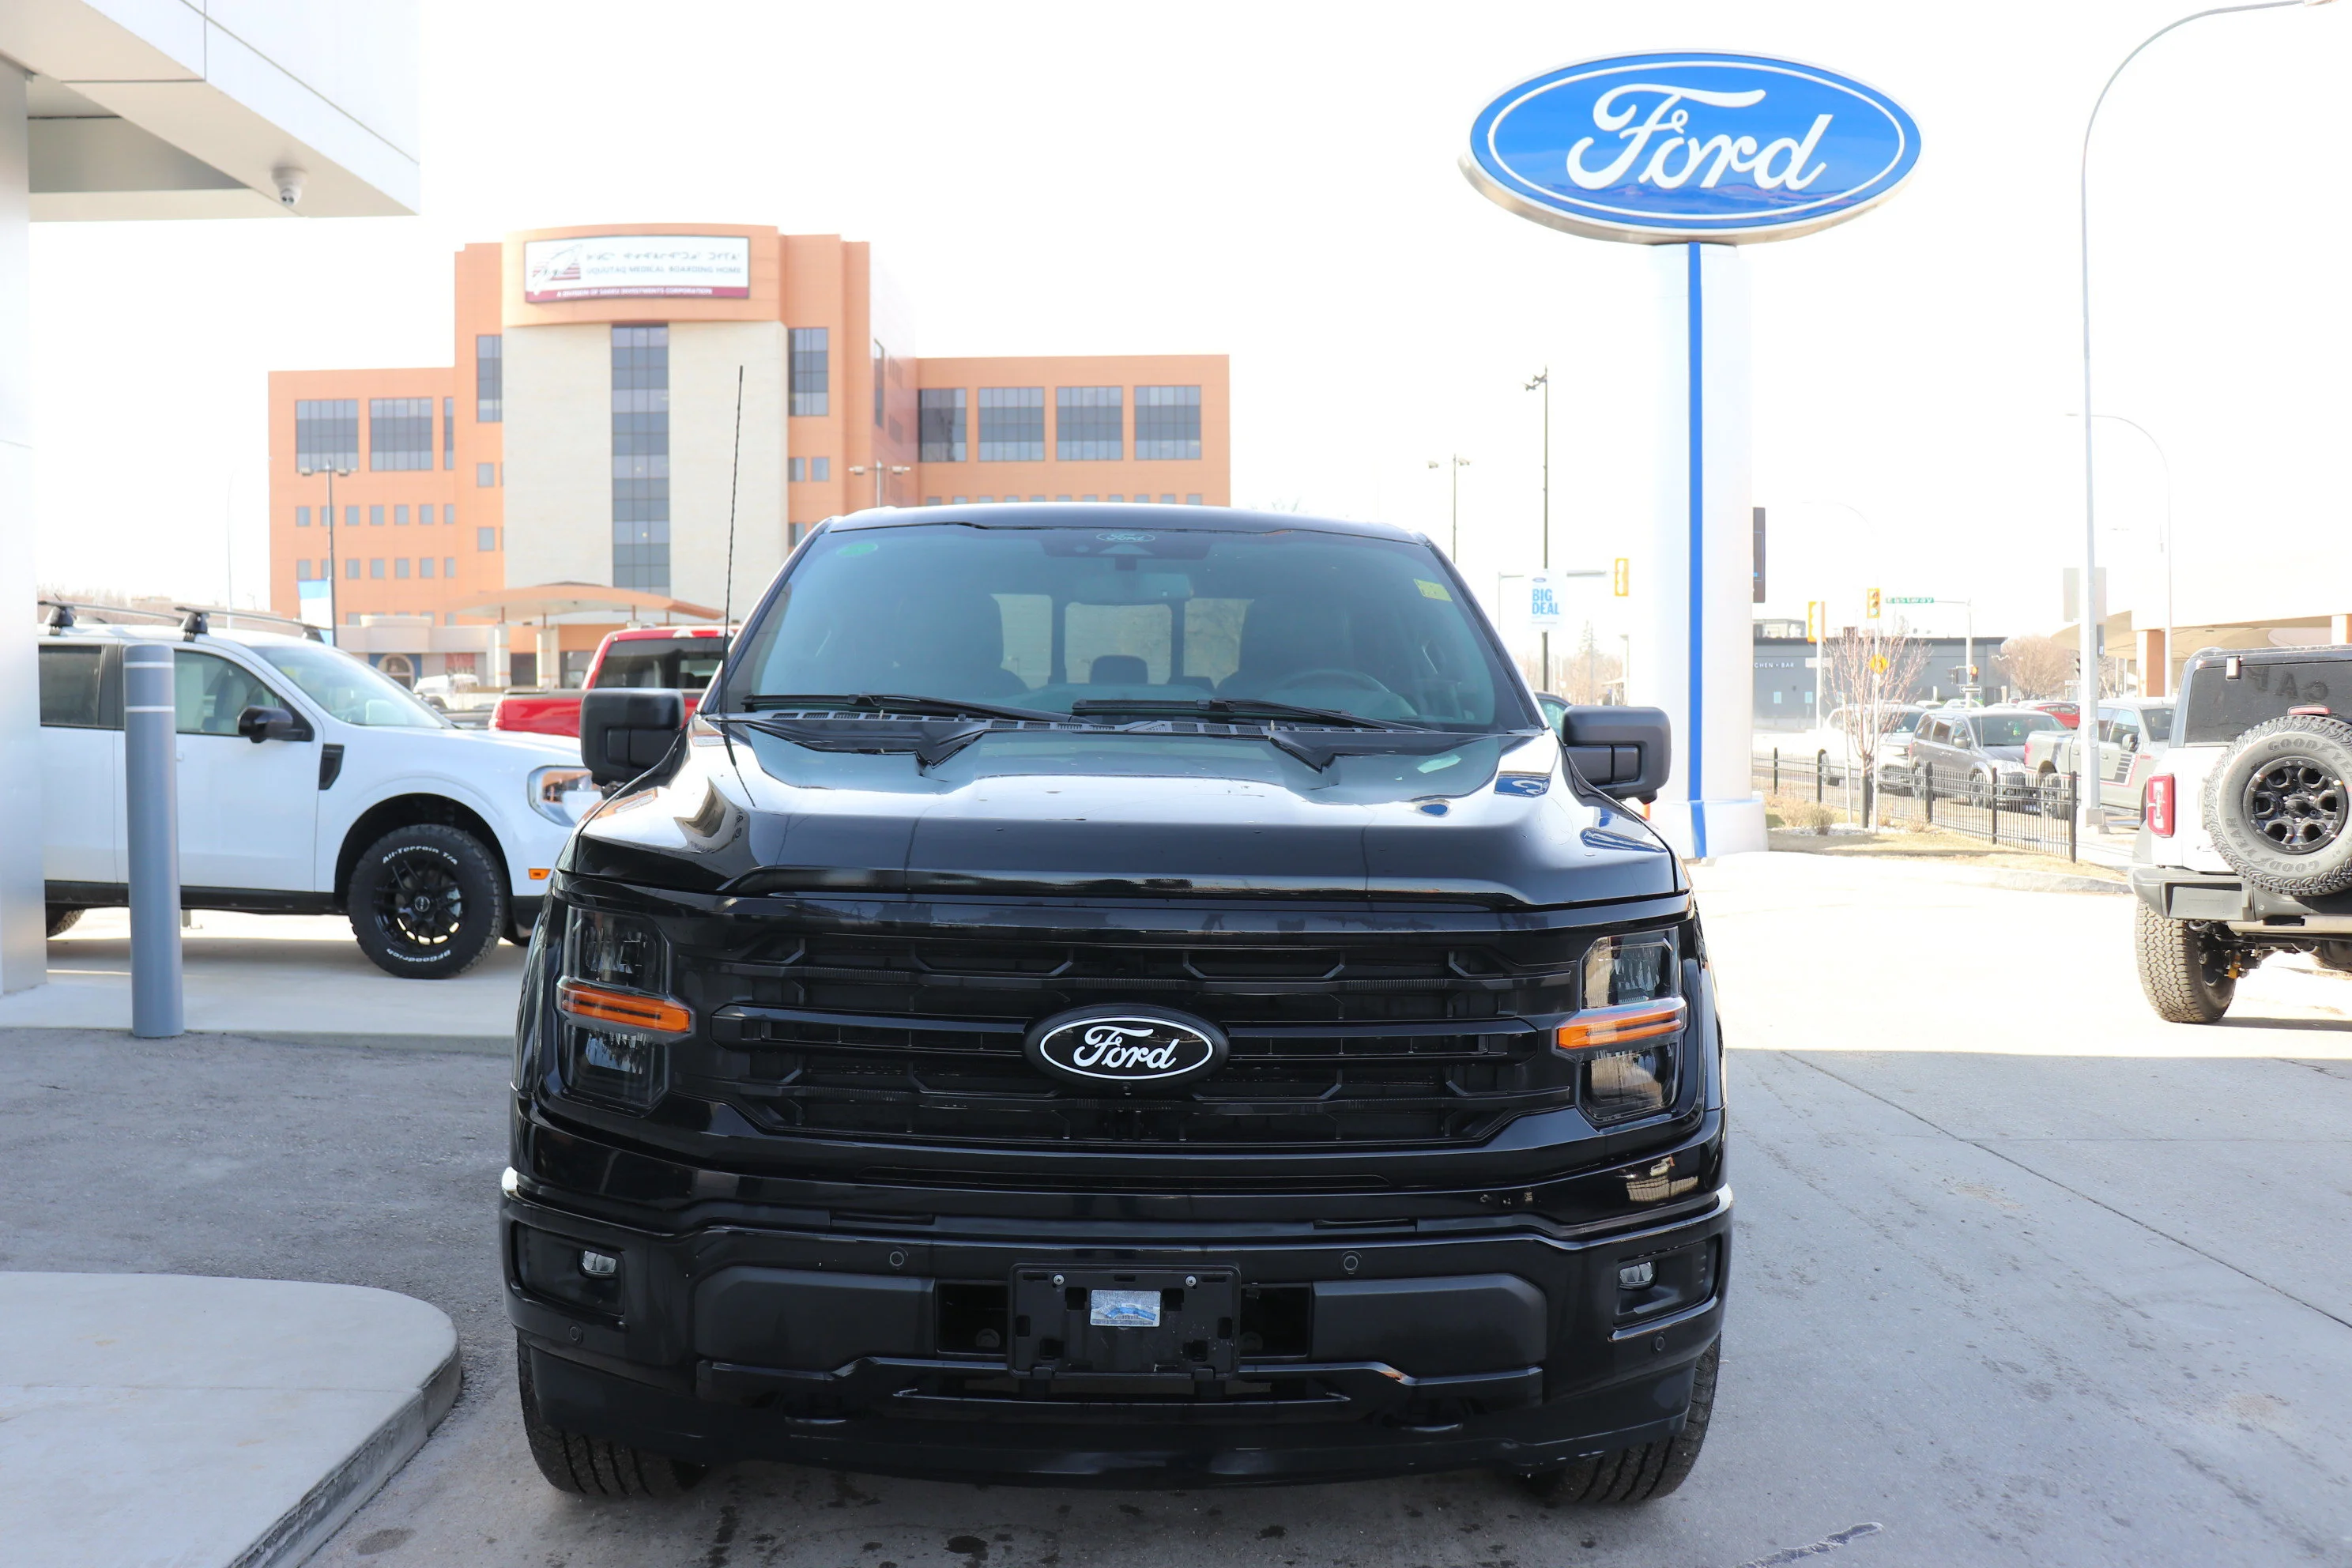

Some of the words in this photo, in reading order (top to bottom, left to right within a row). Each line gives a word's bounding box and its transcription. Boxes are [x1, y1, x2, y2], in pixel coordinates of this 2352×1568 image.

[1566, 82, 1834, 190] Ford
[1532, 588, 1553, 601] BIG
[1532, 602, 1559, 615] DEAL
[383, 846, 439, 864] All-Terrain
[442, 851, 458, 866] T/A
[386, 948, 452, 963] BFGoodrich
[1073, 1025, 1179, 1069] Ford
